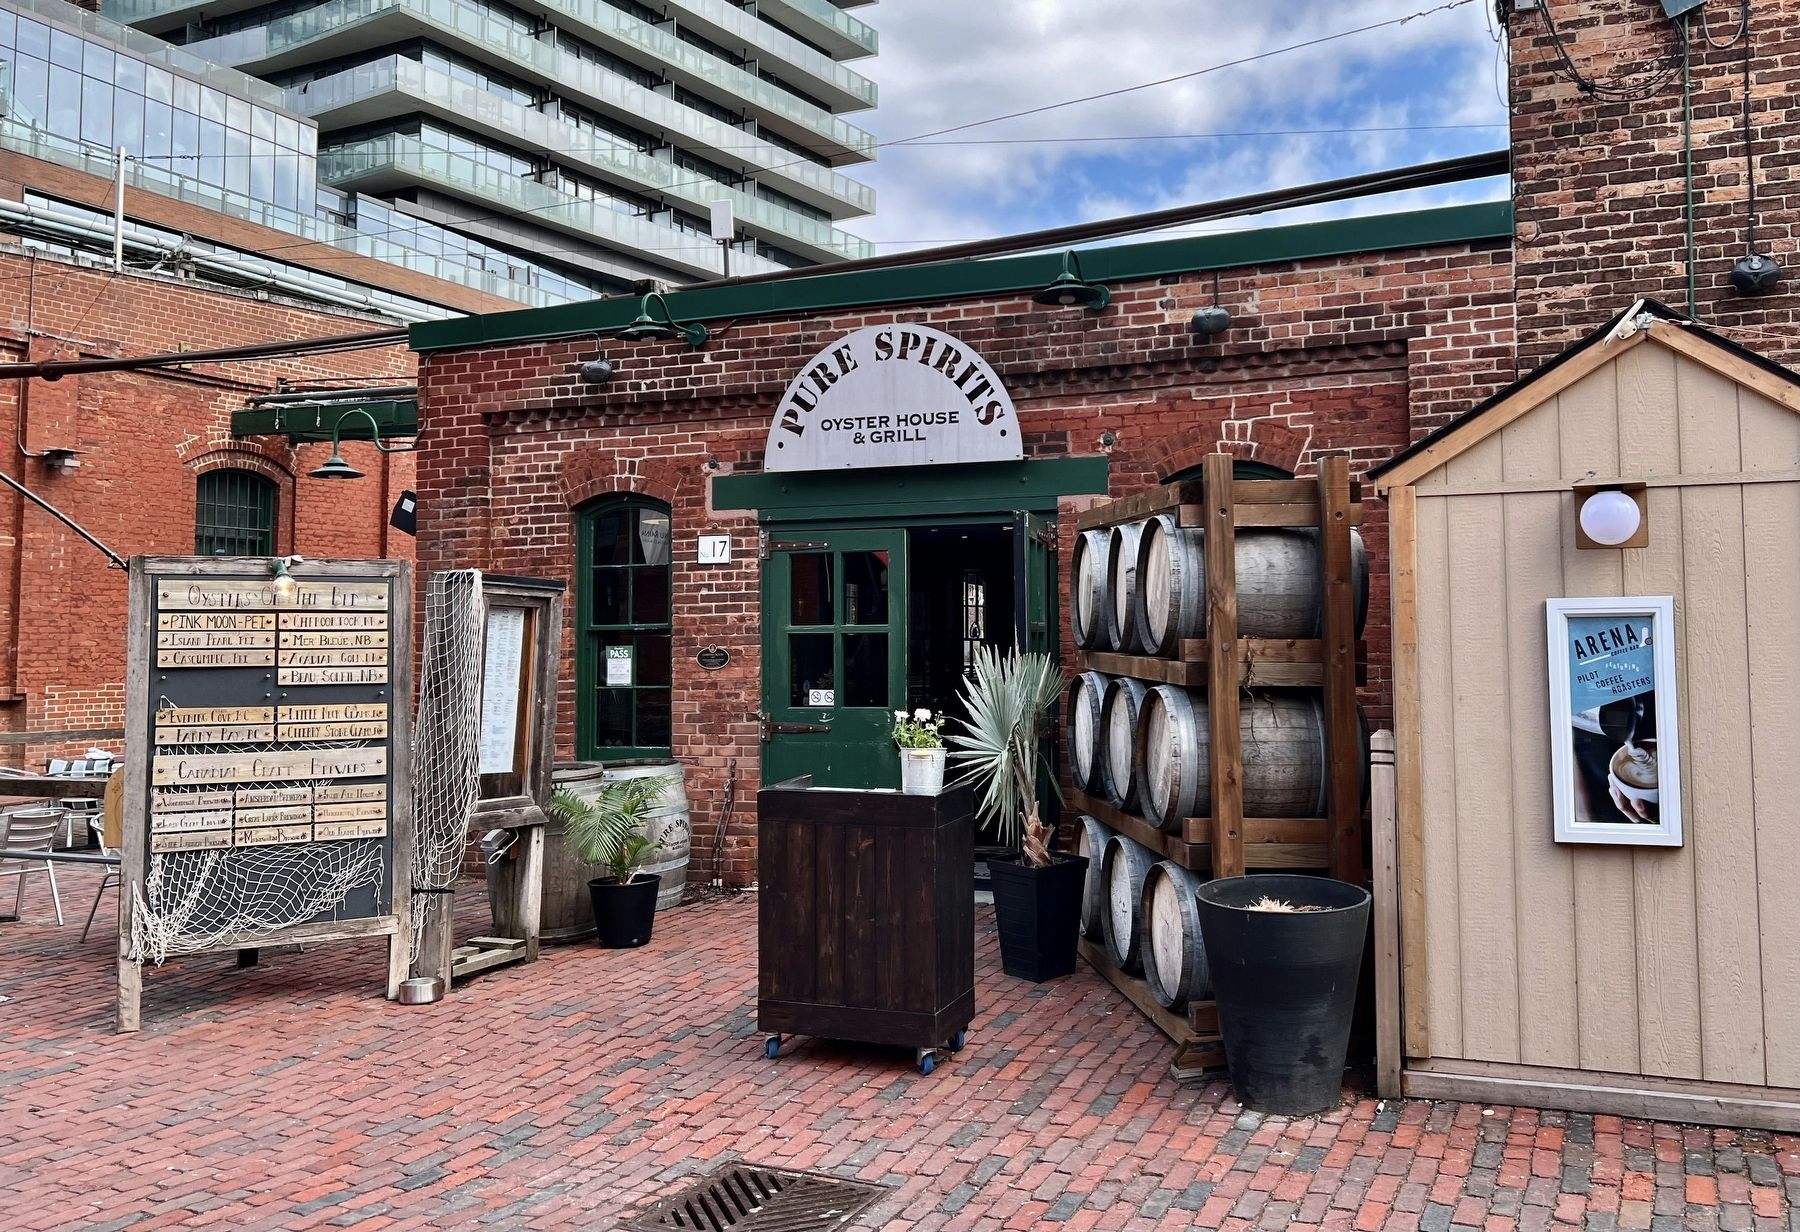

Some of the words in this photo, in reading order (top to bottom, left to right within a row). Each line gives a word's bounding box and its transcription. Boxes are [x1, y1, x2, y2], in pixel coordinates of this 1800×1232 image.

[780, 343, 859, 438] PURE
[874, 331, 1006, 426] SPIRITS
[820, 415, 890, 431] OYSTER
[896, 411, 960, 427] HOUSE
[853, 432, 866, 444] &
[870, 428, 927, 443] GRILL
[712, 540, 727, 557] 17
[170, 615, 201, 629] PINK
[1574, 623, 1639, 660] ARENA
[610, 650, 629, 658] PASS
[1610, 647, 1628, 656] COFFEE
[1605, 661, 1639, 672] FEATURING
[1577, 671, 1599, 684] PILOT
[1595, 674, 1624, 689] COFFEE
[1611, 676, 1651, 695] ROASTERS
